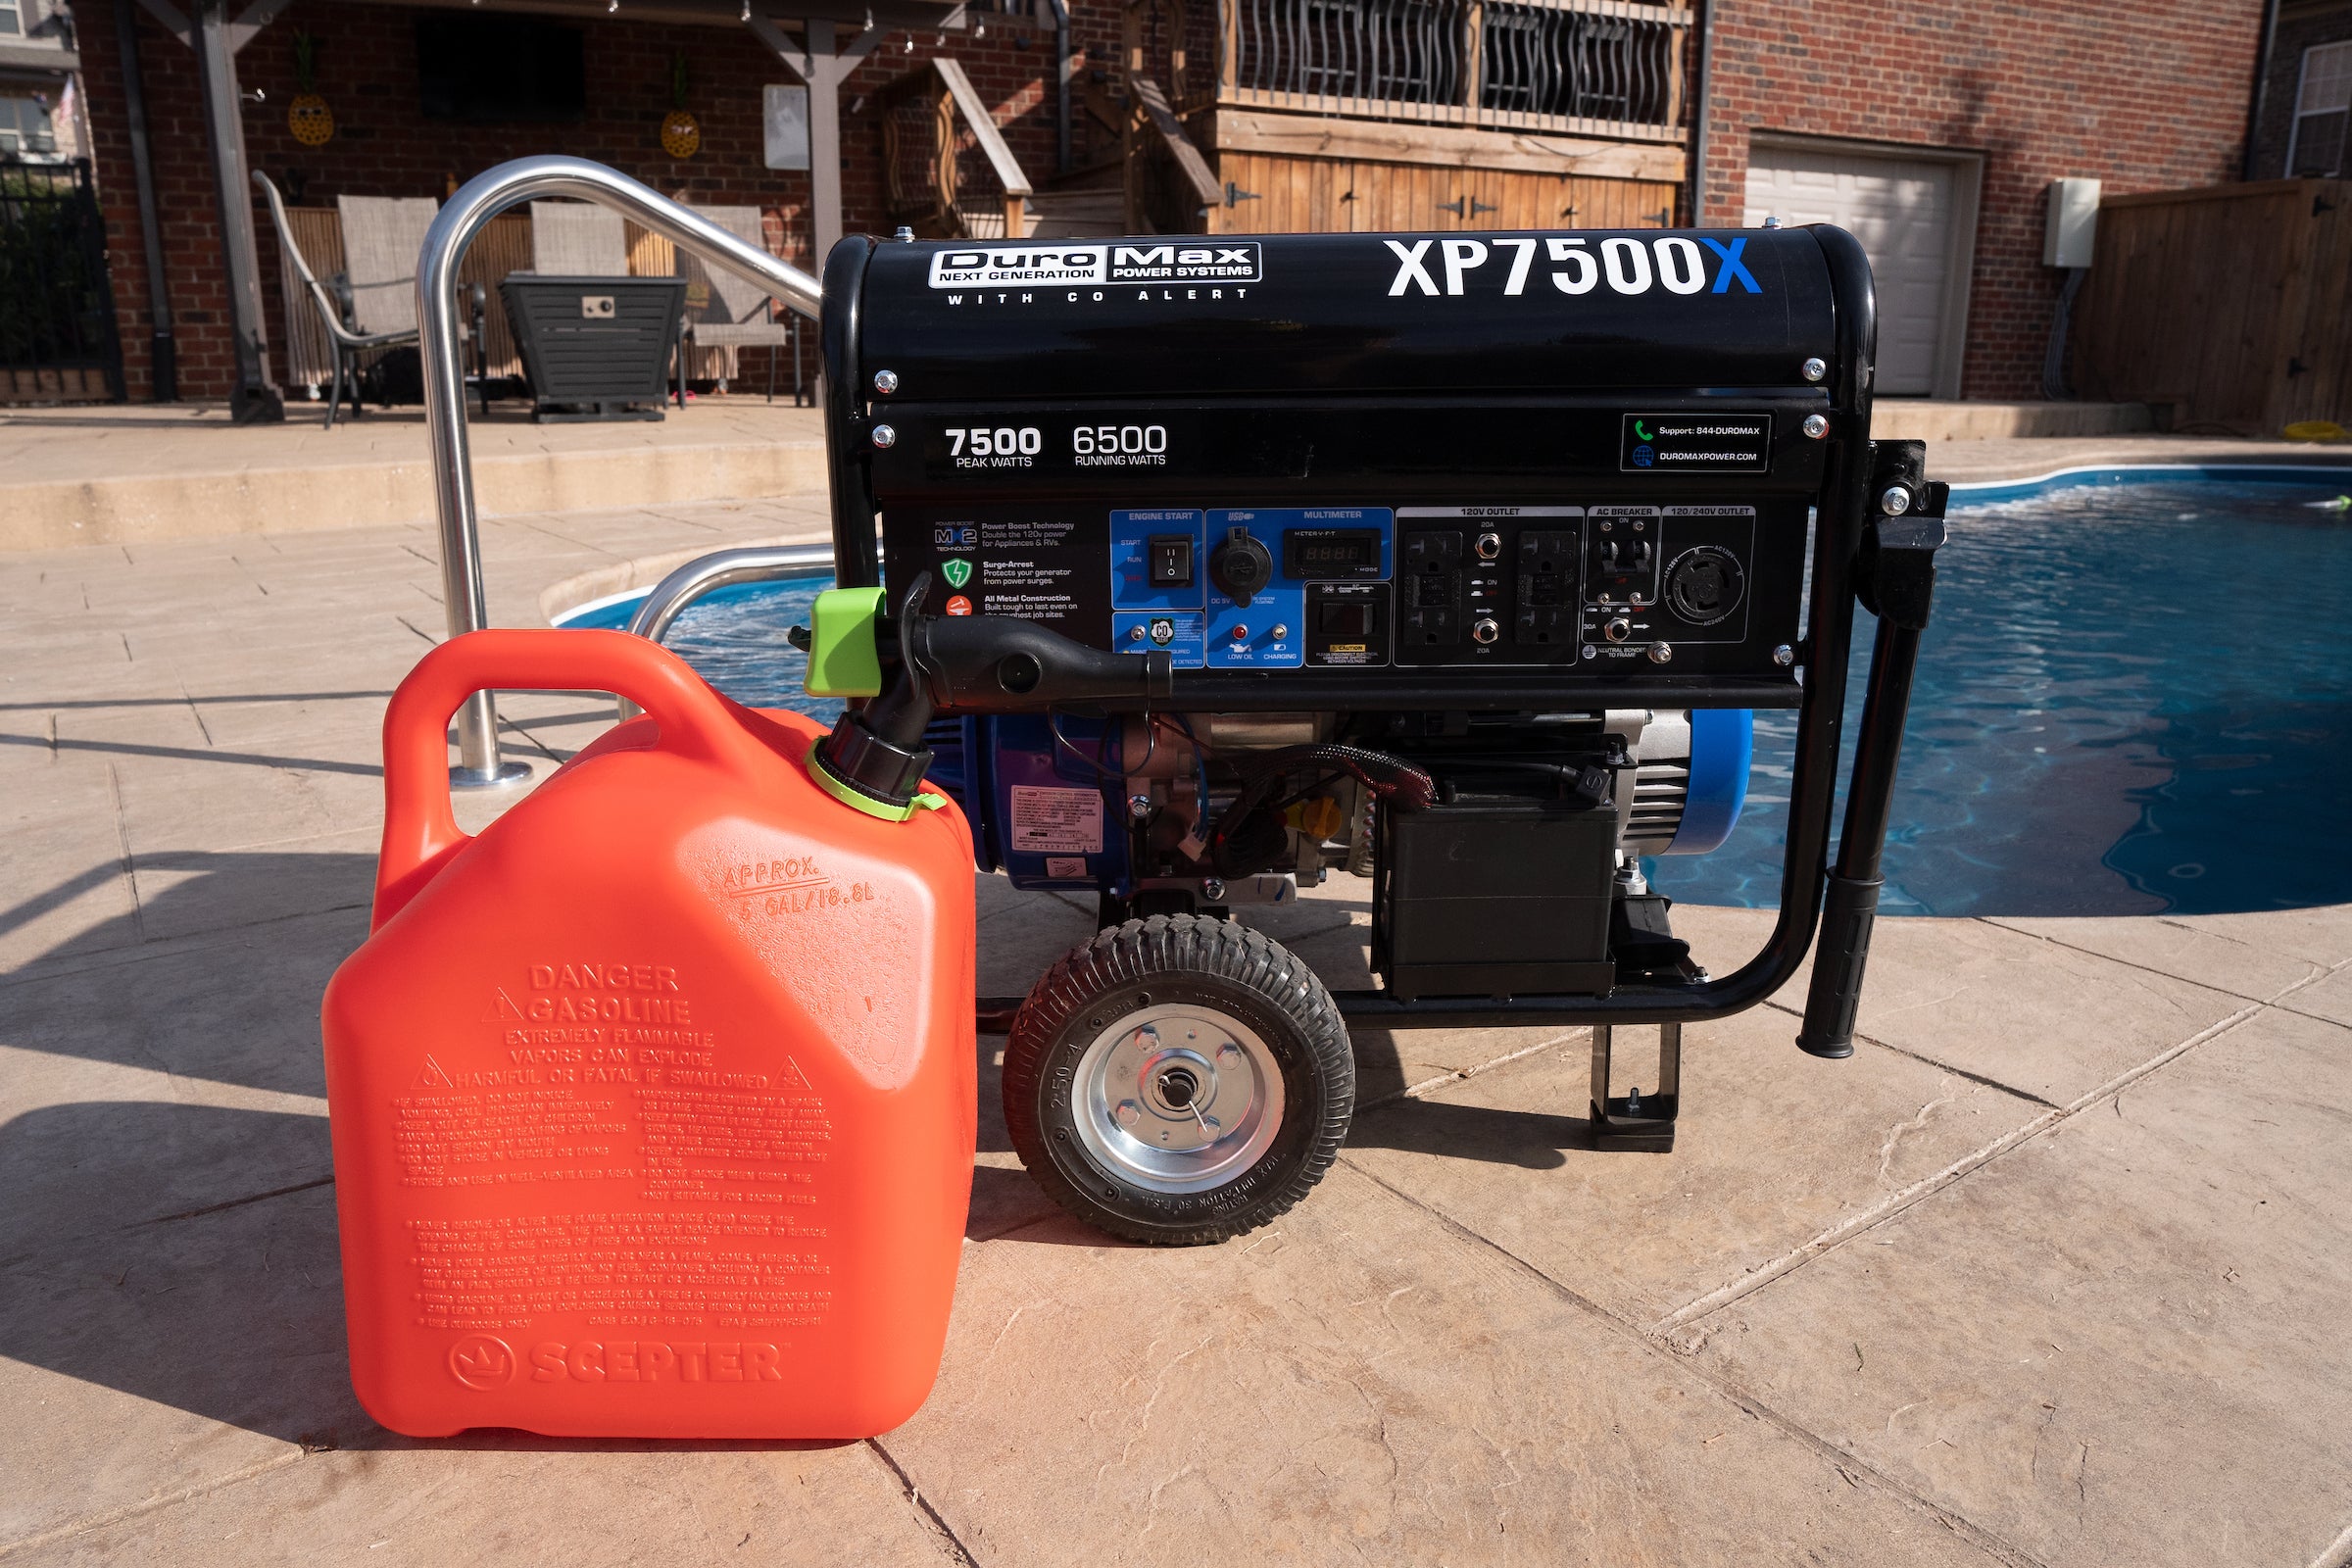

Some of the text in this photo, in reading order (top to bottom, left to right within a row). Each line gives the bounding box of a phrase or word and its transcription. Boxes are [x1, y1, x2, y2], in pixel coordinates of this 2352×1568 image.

[942, 246, 1251, 270] Duro Max
[939, 270, 1095, 281] NEXT GENERATION
[1113, 266, 1253, 277] POWER SYSTEMS
[1383, 242, 1763, 301] XP7500X
[948, 288, 1247, 305] WITH CO ALERT
[1659, 426, 1694, 436] Support:
[945, 425, 1167, 456] 7500 6500
[1075, 455, 1166, 466] RUNNING WATTS
[1659, 452, 1757, 461] DUROMAXPOWER.COM
[956, 457, 1033, 468] PEAK WATTS
[1165, 512, 1194, 520] START
[1303, 511, 1362, 519] MULTIMETER
[1032, 521, 1074, 530] Technology
[1044, 532, 1067, 541] power
[982, 539, 994, 548] for
[994, 539, 1034, 549] Appliances
[1035, 539, 1043, 548] &
[983, 561, 1034, 570] Surge-Arrest
[983, 568, 1016, 577] Protects
[1034, 569, 1072, 578] generator
[1003, 578, 1026, 587] power
[1026, 578, 1055, 587] surges.
[1020, 594, 1071, 603] Construction
[985, 603, 1002, 612] Built
[1003, 603, 1024, 612] tough
[1033, 612, 1044, 620] job
[1156, 625, 1168, 637] CO
[723, 857, 820, 888] APPROX.
[741, 882, 875, 920] 5 GAL/18.8L
[529, 963, 680, 991] DANGER
[526, 997, 692, 1025] GASOLINE
[504, 1027, 714, 1048] EXTREMELY FLAMMABLE
[510, 1049, 713, 1067] VAPORS CAN EXPLODE
[455, 1067, 768, 1090] HARMFUL OR FATAL IF SWALLOWED
[529, 1341, 783, 1383] SCEPTER
